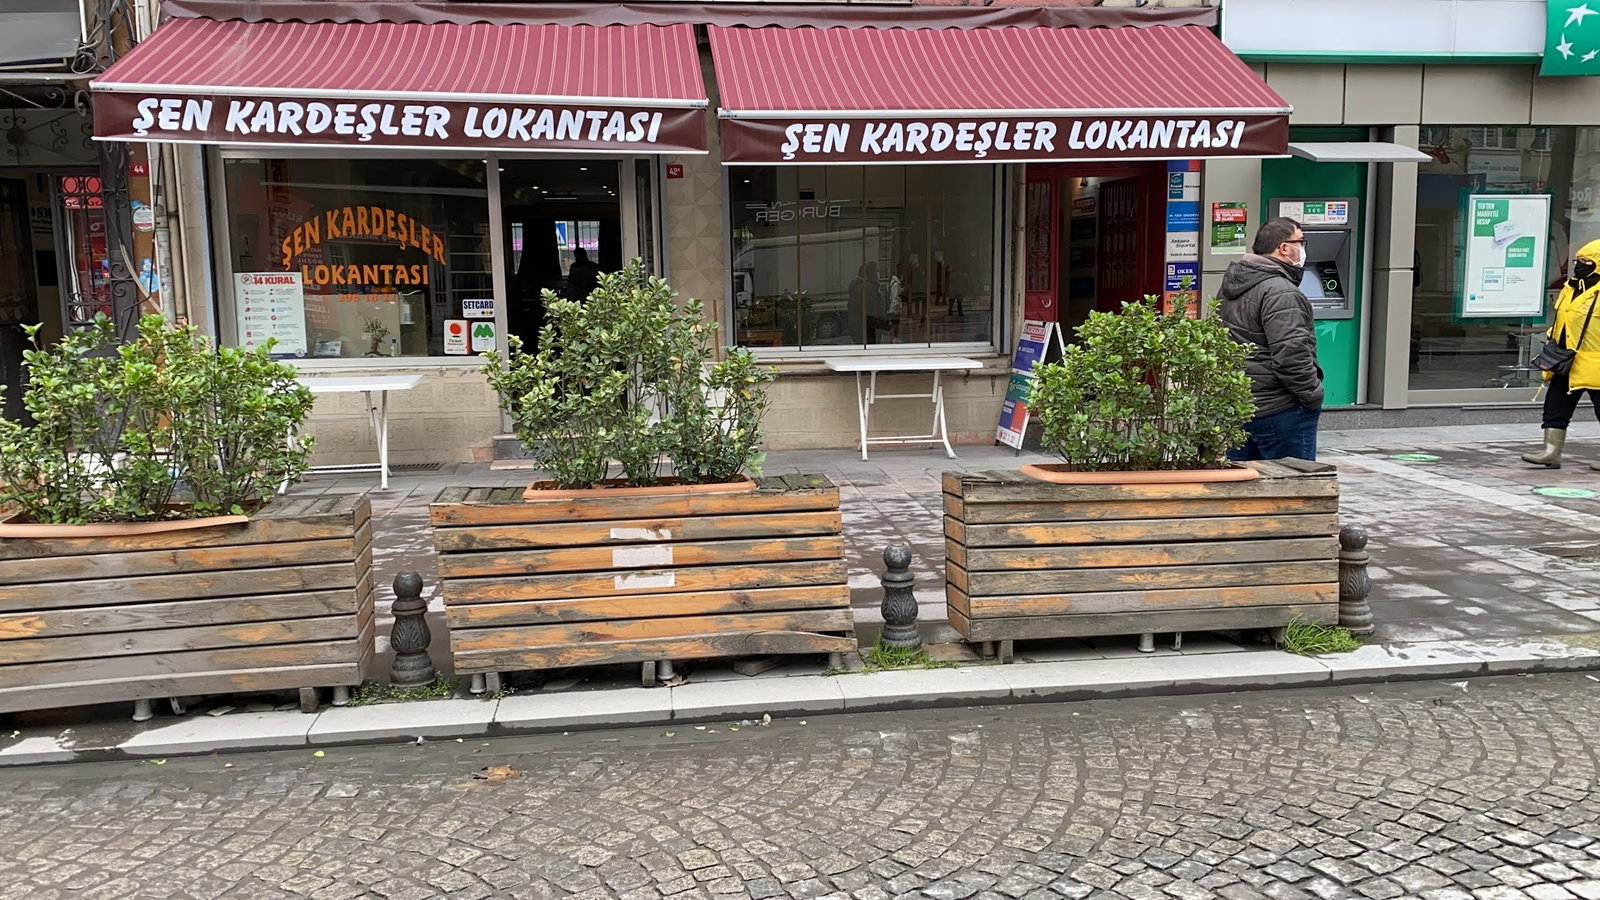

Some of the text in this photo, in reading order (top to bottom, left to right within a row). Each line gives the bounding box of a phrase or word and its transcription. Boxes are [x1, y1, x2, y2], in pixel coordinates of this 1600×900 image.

[132, 98, 663, 143] ŞEN KARDEŞLER LOKANTASI
[781, 119, 1246, 160] ŞEN KARDEŞLER LOKANTASI
[134, 165, 144, 173] 44
[281, 215, 320, 271] ŞEN
[326, 206, 446, 266] KARDEŞLER
[253, 276, 295, 285] 14 KURAL
[302, 264, 429, 285] LOKANTASI
[463, 300, 494, 310] SETCARD
